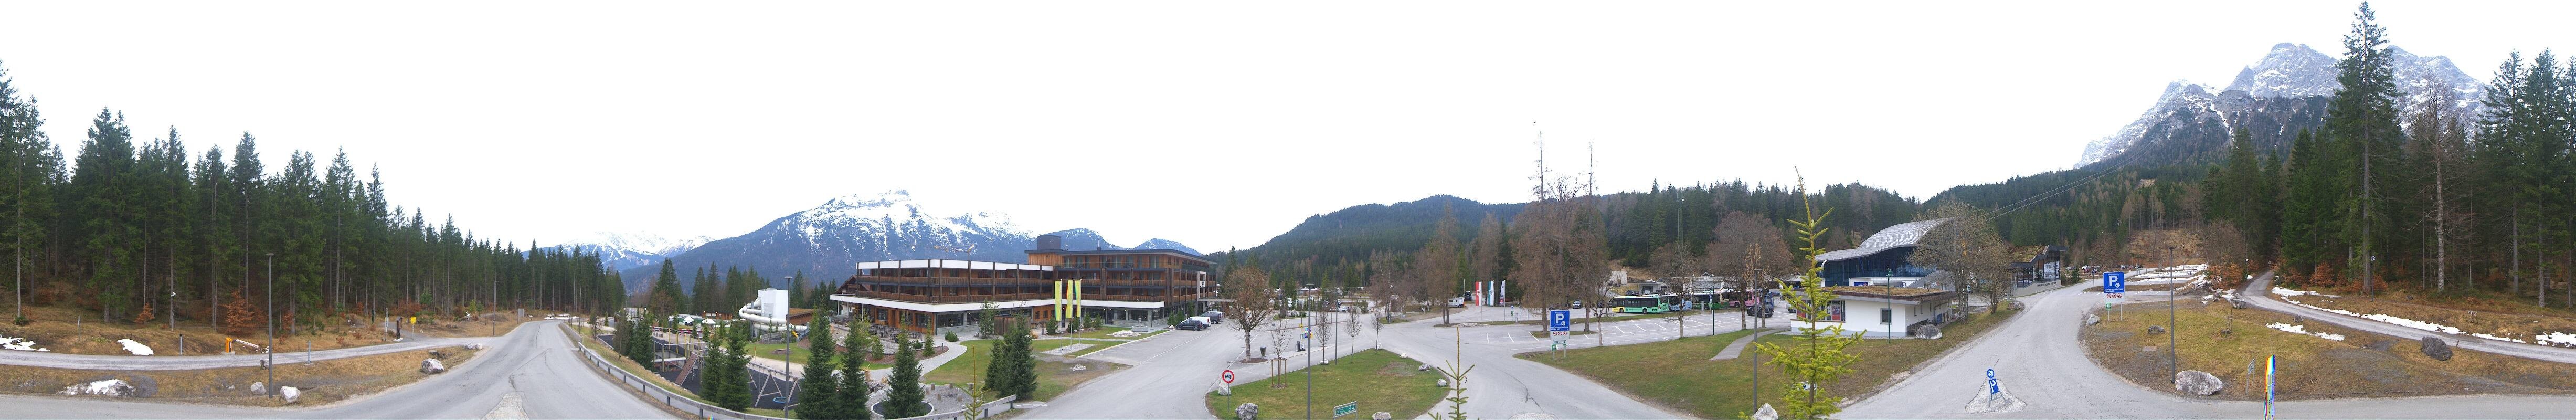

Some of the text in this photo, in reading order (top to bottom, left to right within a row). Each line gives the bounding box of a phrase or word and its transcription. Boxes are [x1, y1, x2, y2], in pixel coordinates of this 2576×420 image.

[2109, 275, 2118, 286] P
[1555, 313, 1564, 324] P
[1990, 380, 1996, 393] P
